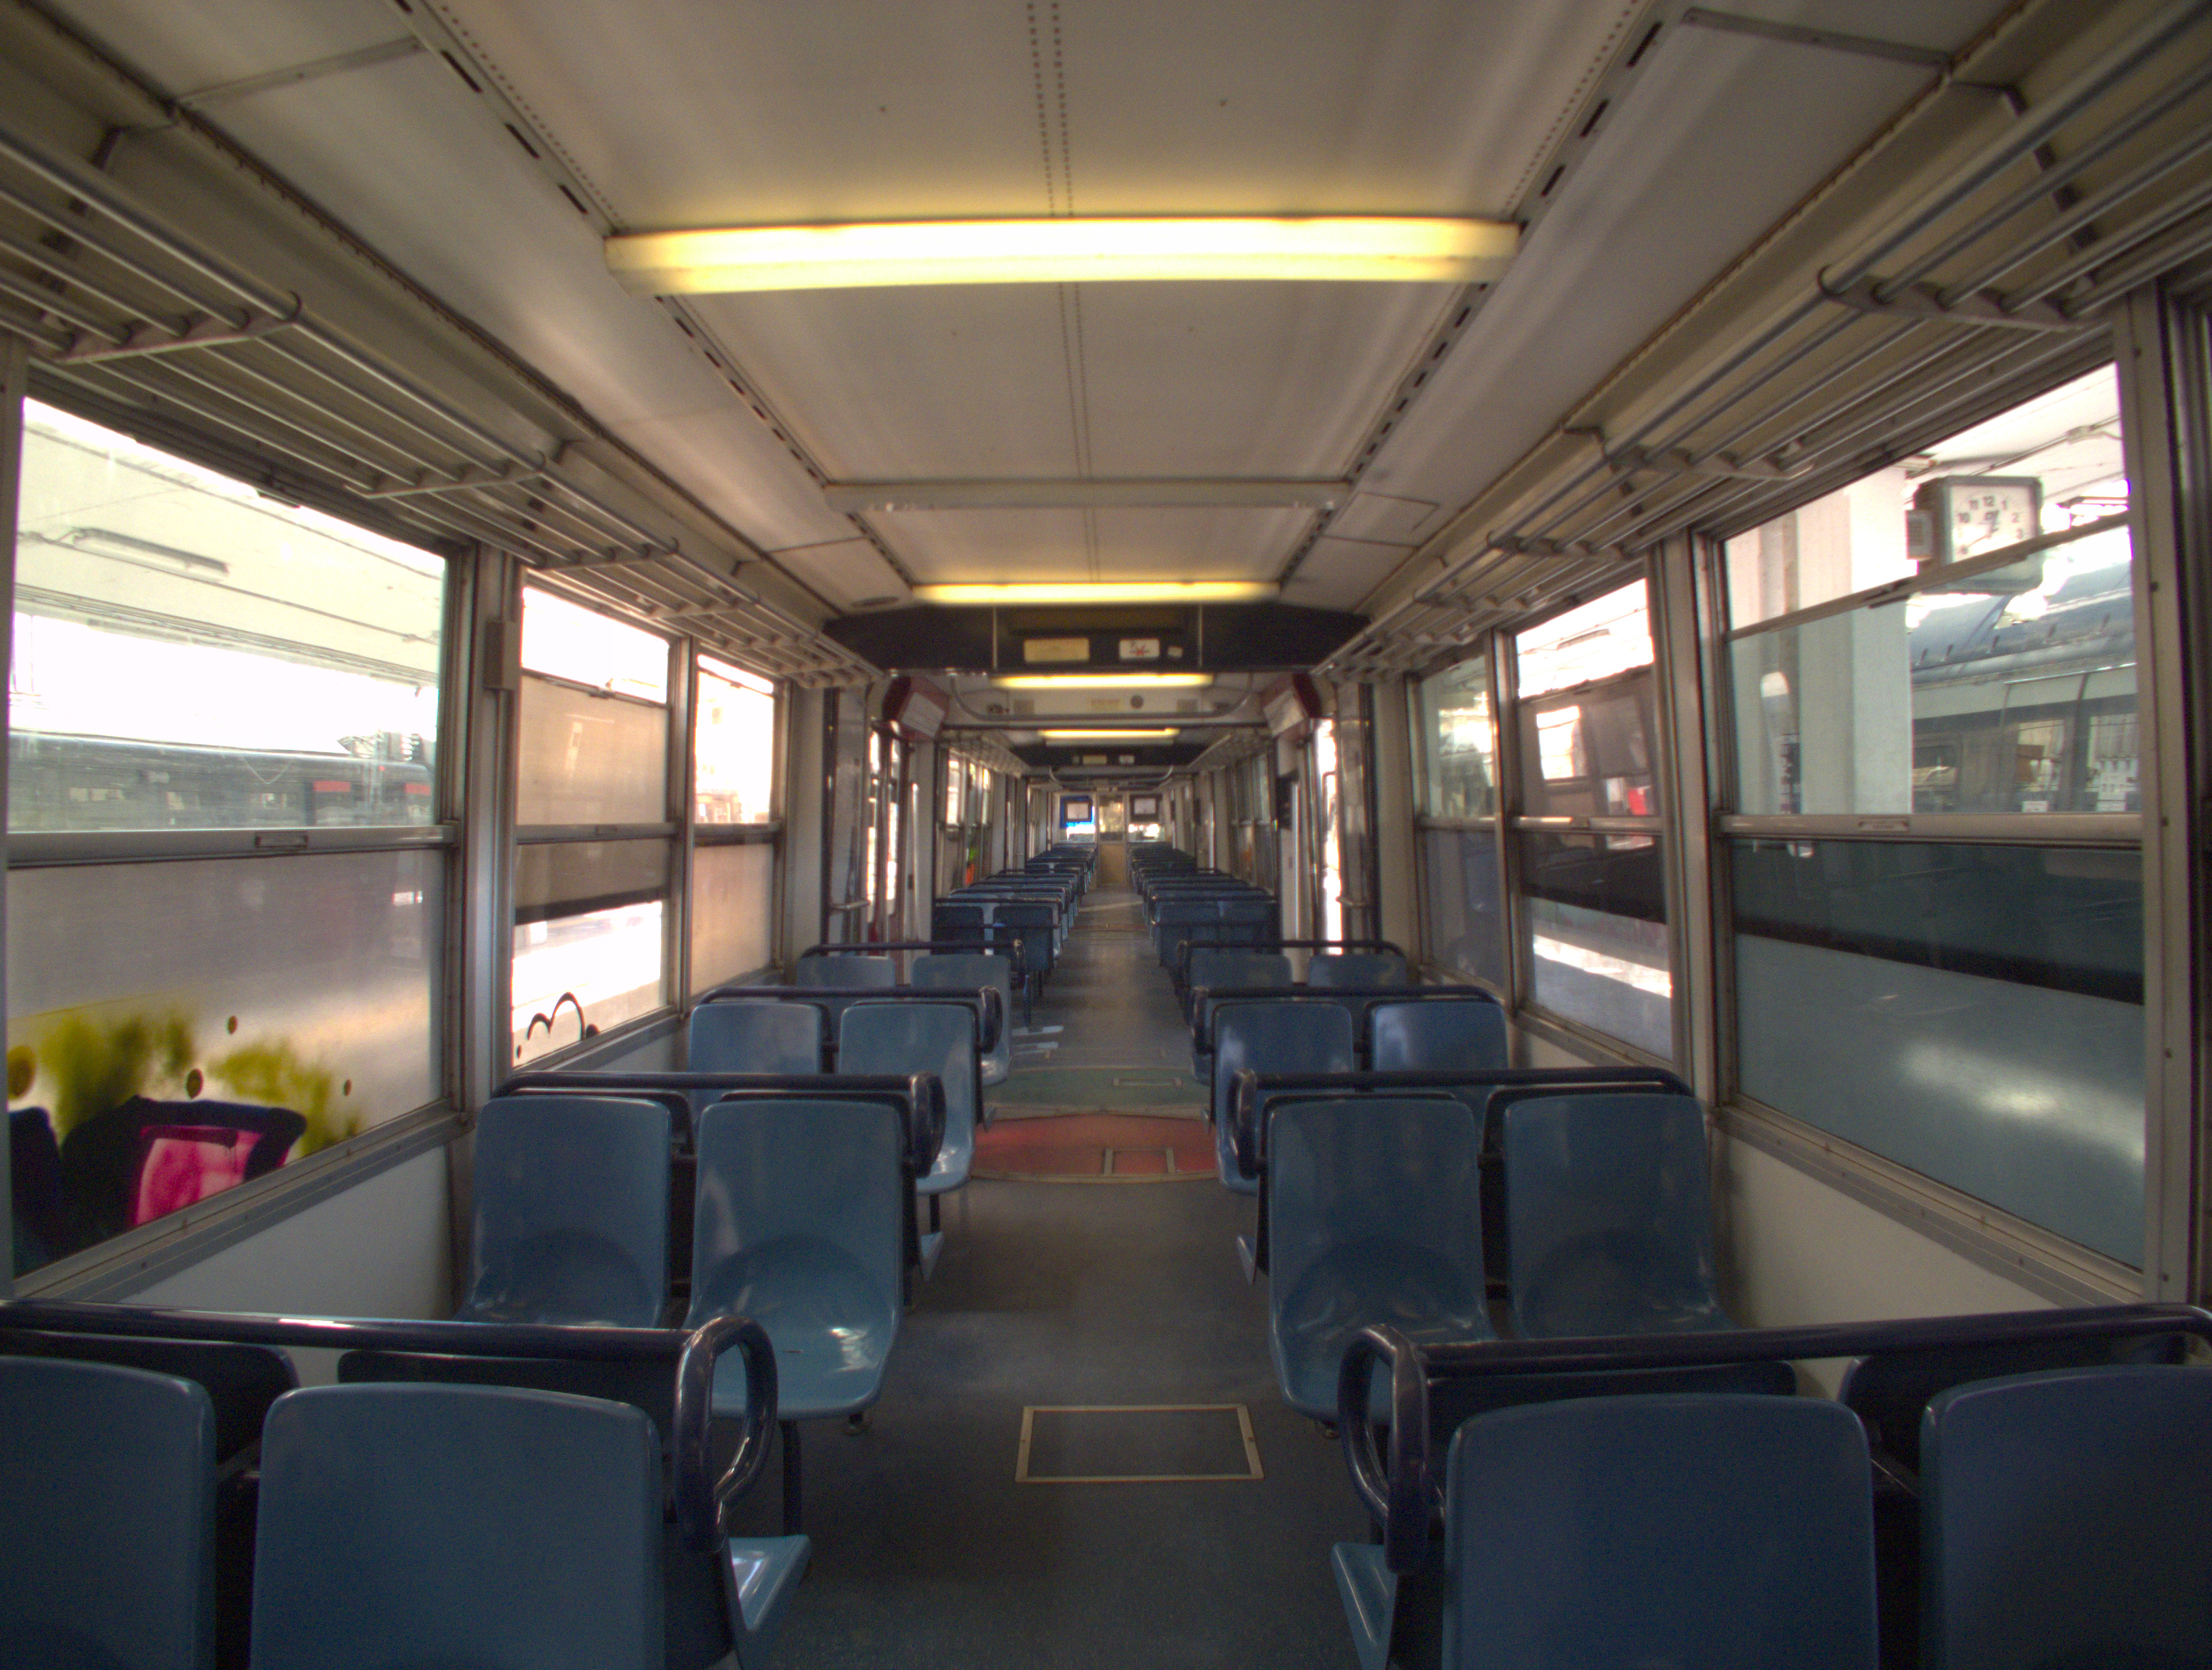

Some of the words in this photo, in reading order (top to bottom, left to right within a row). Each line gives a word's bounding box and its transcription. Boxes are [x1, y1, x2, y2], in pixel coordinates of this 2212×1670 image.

[1968, 499, 1979, 510] 11
[1983, 496, 1995, 507] 12
[2001, 500, 2007, 511] 1
[1958, 512, 1970, 523] 10
[2011, 512, 2020, 523] 2
